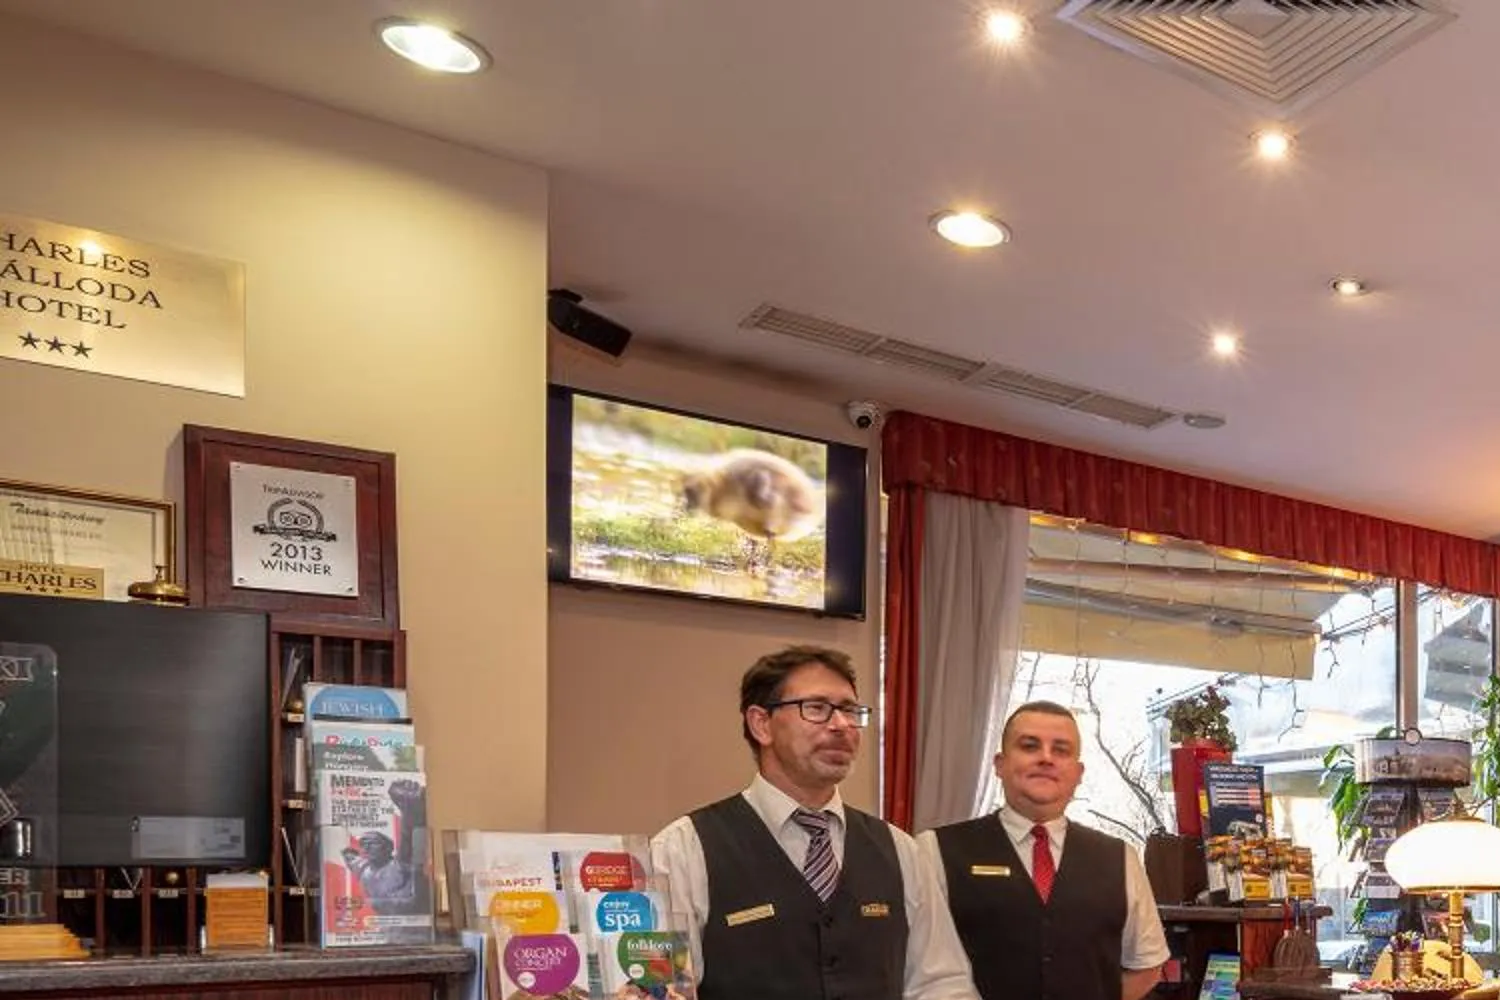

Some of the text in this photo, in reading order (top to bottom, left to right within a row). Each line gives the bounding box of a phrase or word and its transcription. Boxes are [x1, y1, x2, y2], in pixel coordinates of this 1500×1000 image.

[270, 541, 323, 561] 2013
[260, 559, 333, 576] WINNER
[321, 701, 385, 715] JEWISH
[605, 913, 641, 932] spa
[627, 938, 673, 951] folklore
[513, 946, 568, 960] ORGAN
